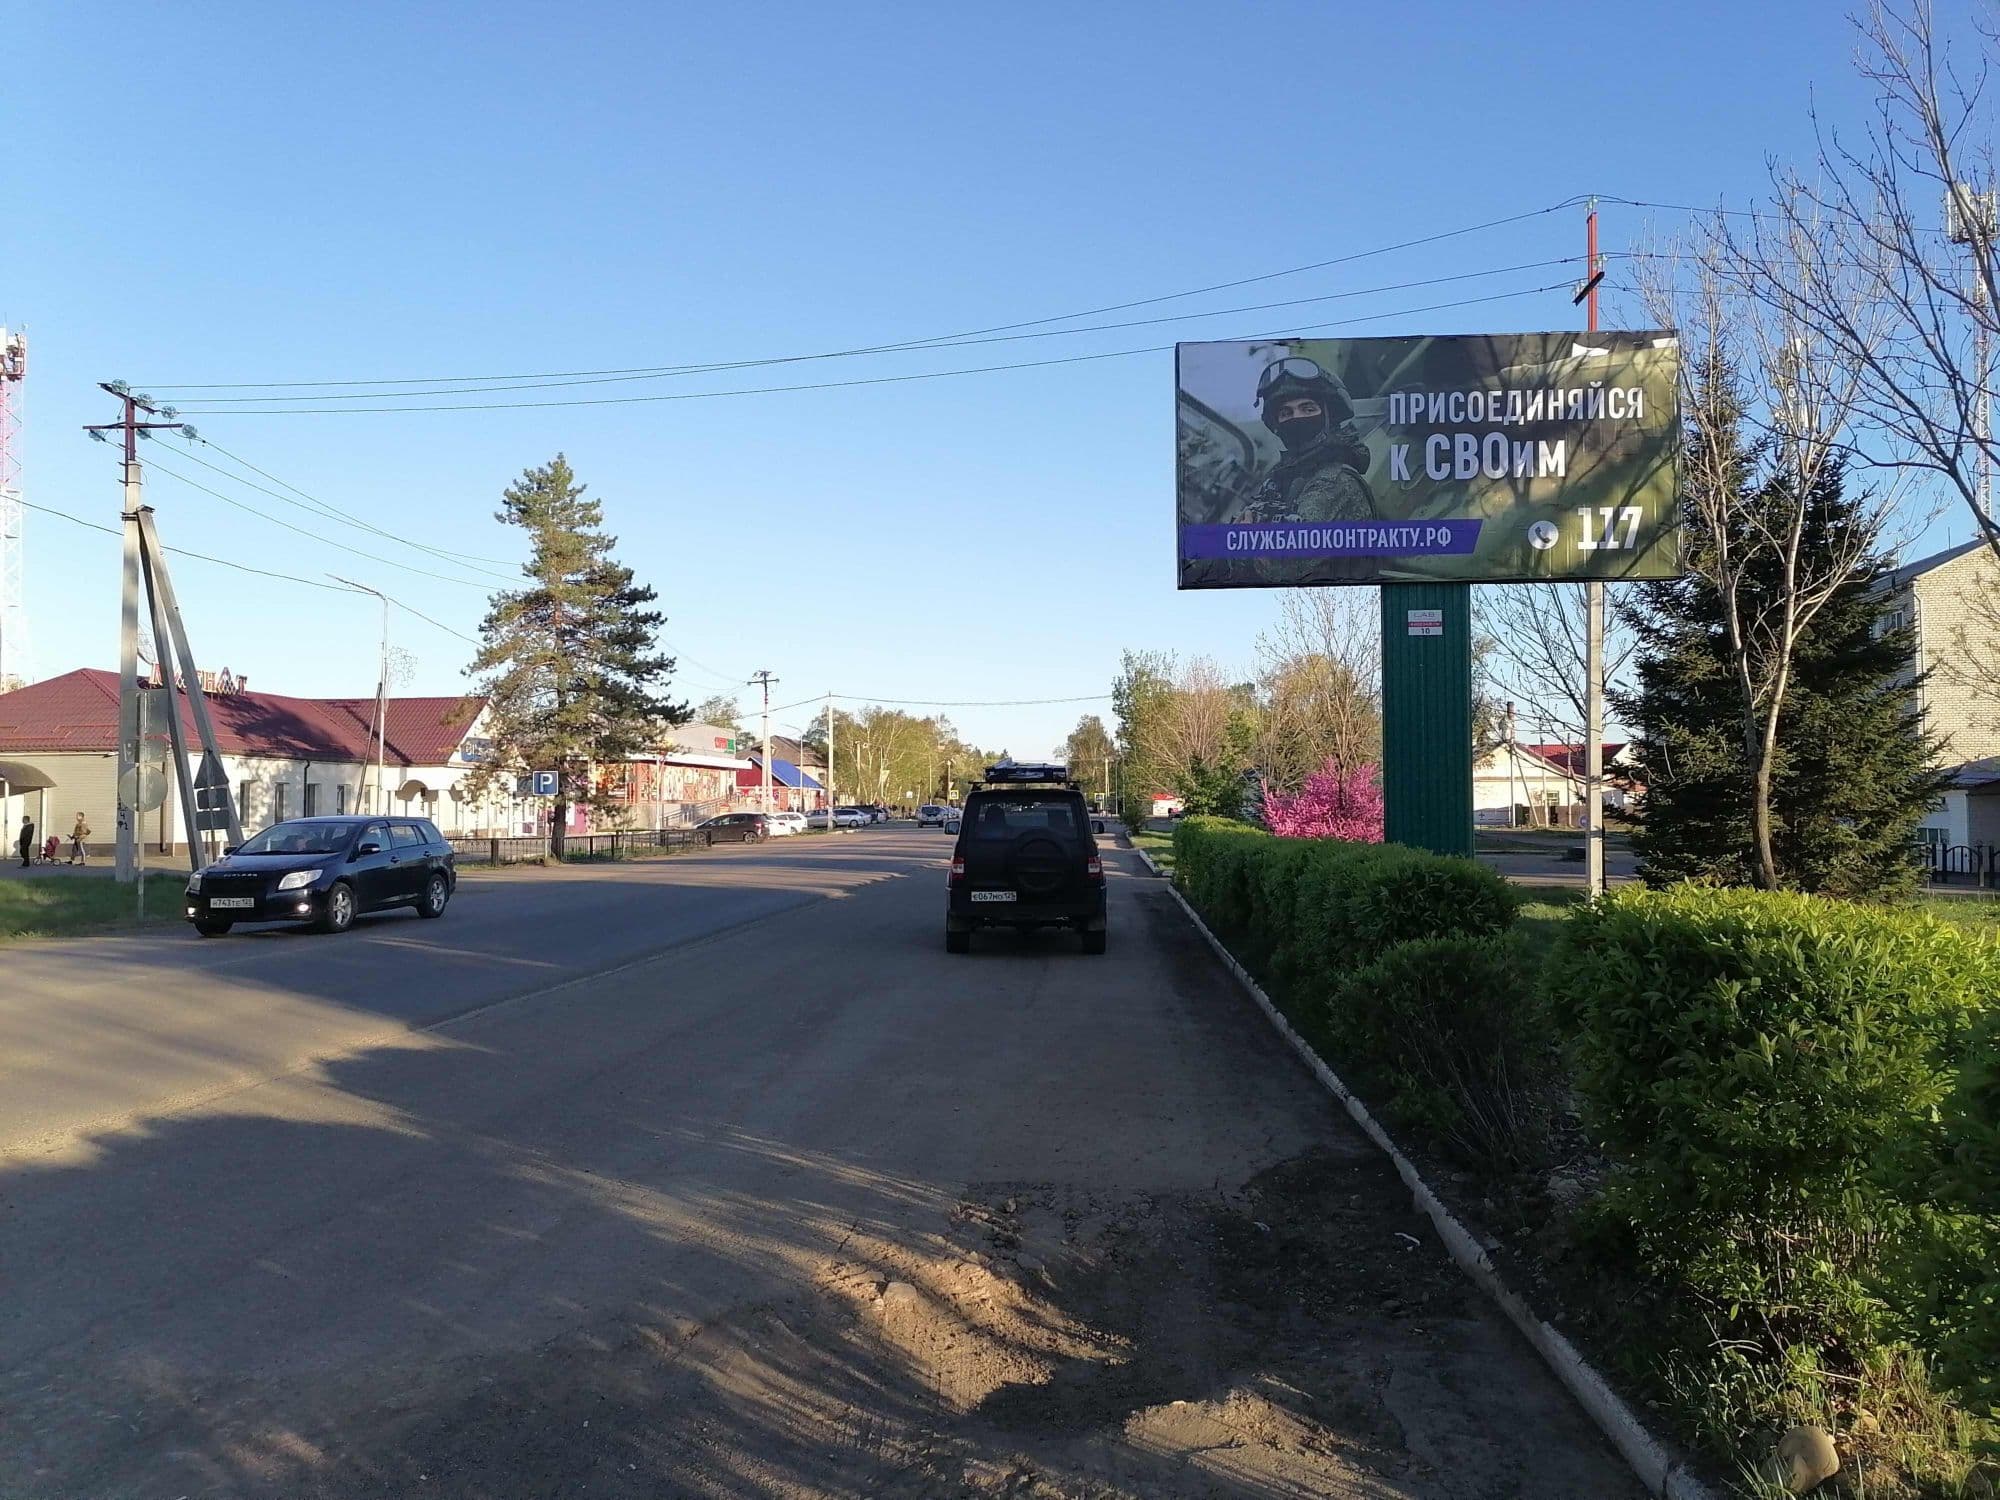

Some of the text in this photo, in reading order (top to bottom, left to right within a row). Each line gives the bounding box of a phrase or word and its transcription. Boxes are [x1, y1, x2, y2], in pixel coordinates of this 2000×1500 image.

[1389, 381, 1643, 426] ПРИСОЕДИНЯЙСЯ
[1226, 526, 1452, 551] СЛУЖБАПОКОНТРАКТУ.РФ
[1577, 505, 1643, 549] 117
[540, 773, 553, 793] P
